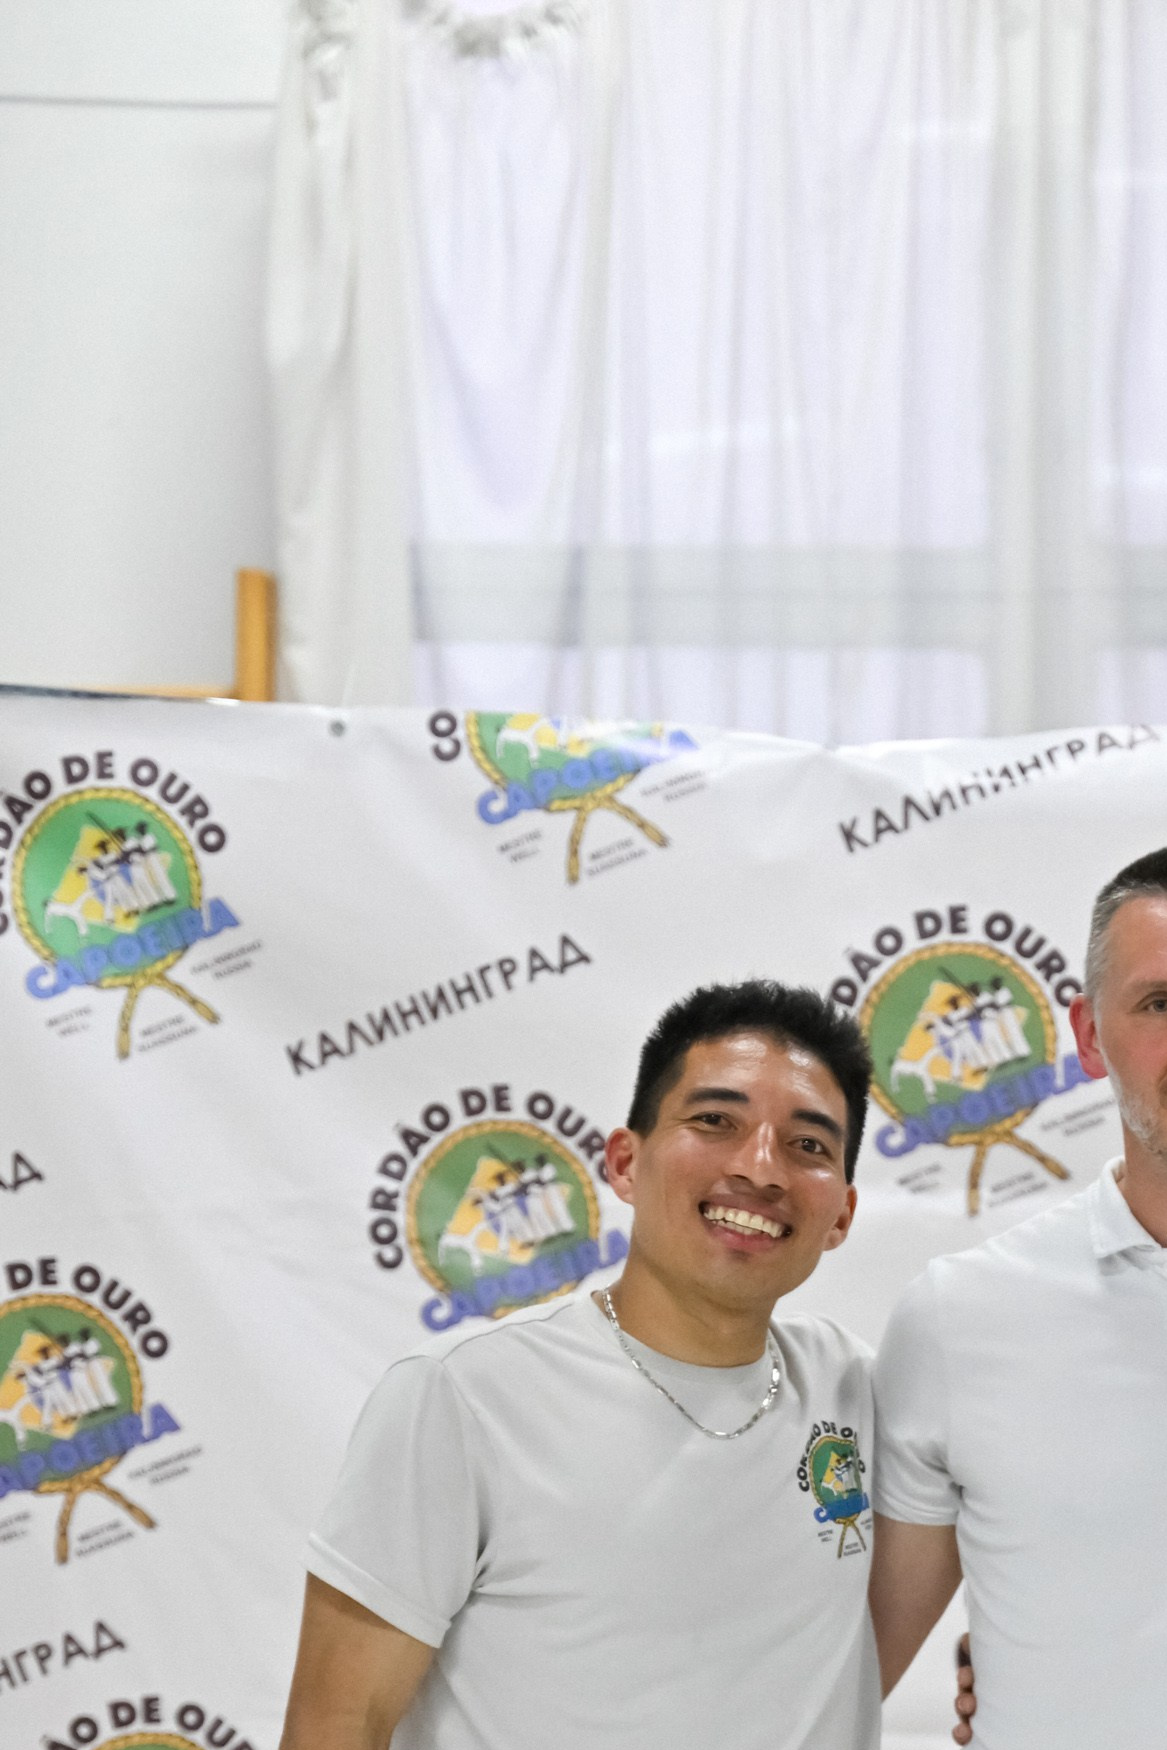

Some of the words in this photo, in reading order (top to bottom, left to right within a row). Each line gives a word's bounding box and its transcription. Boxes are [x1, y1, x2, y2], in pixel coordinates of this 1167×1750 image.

[61, 751, 115, 785] DE
[130, 757, 227, 854] OURO
[914, 904, 969, 940] DE
[285, 931, 592, 1077] КАЛИНИНГРАД
[368, 1102, 452, 1271] CORDÃO
[459, 1084, 512, 1117] DE
[526, 1091, 612, 1184] OUR
[5, 1258, 57, 1291] DE
[73, 1264, 169, 1359] OURO
[108, 1696, 162, 1730] DE
